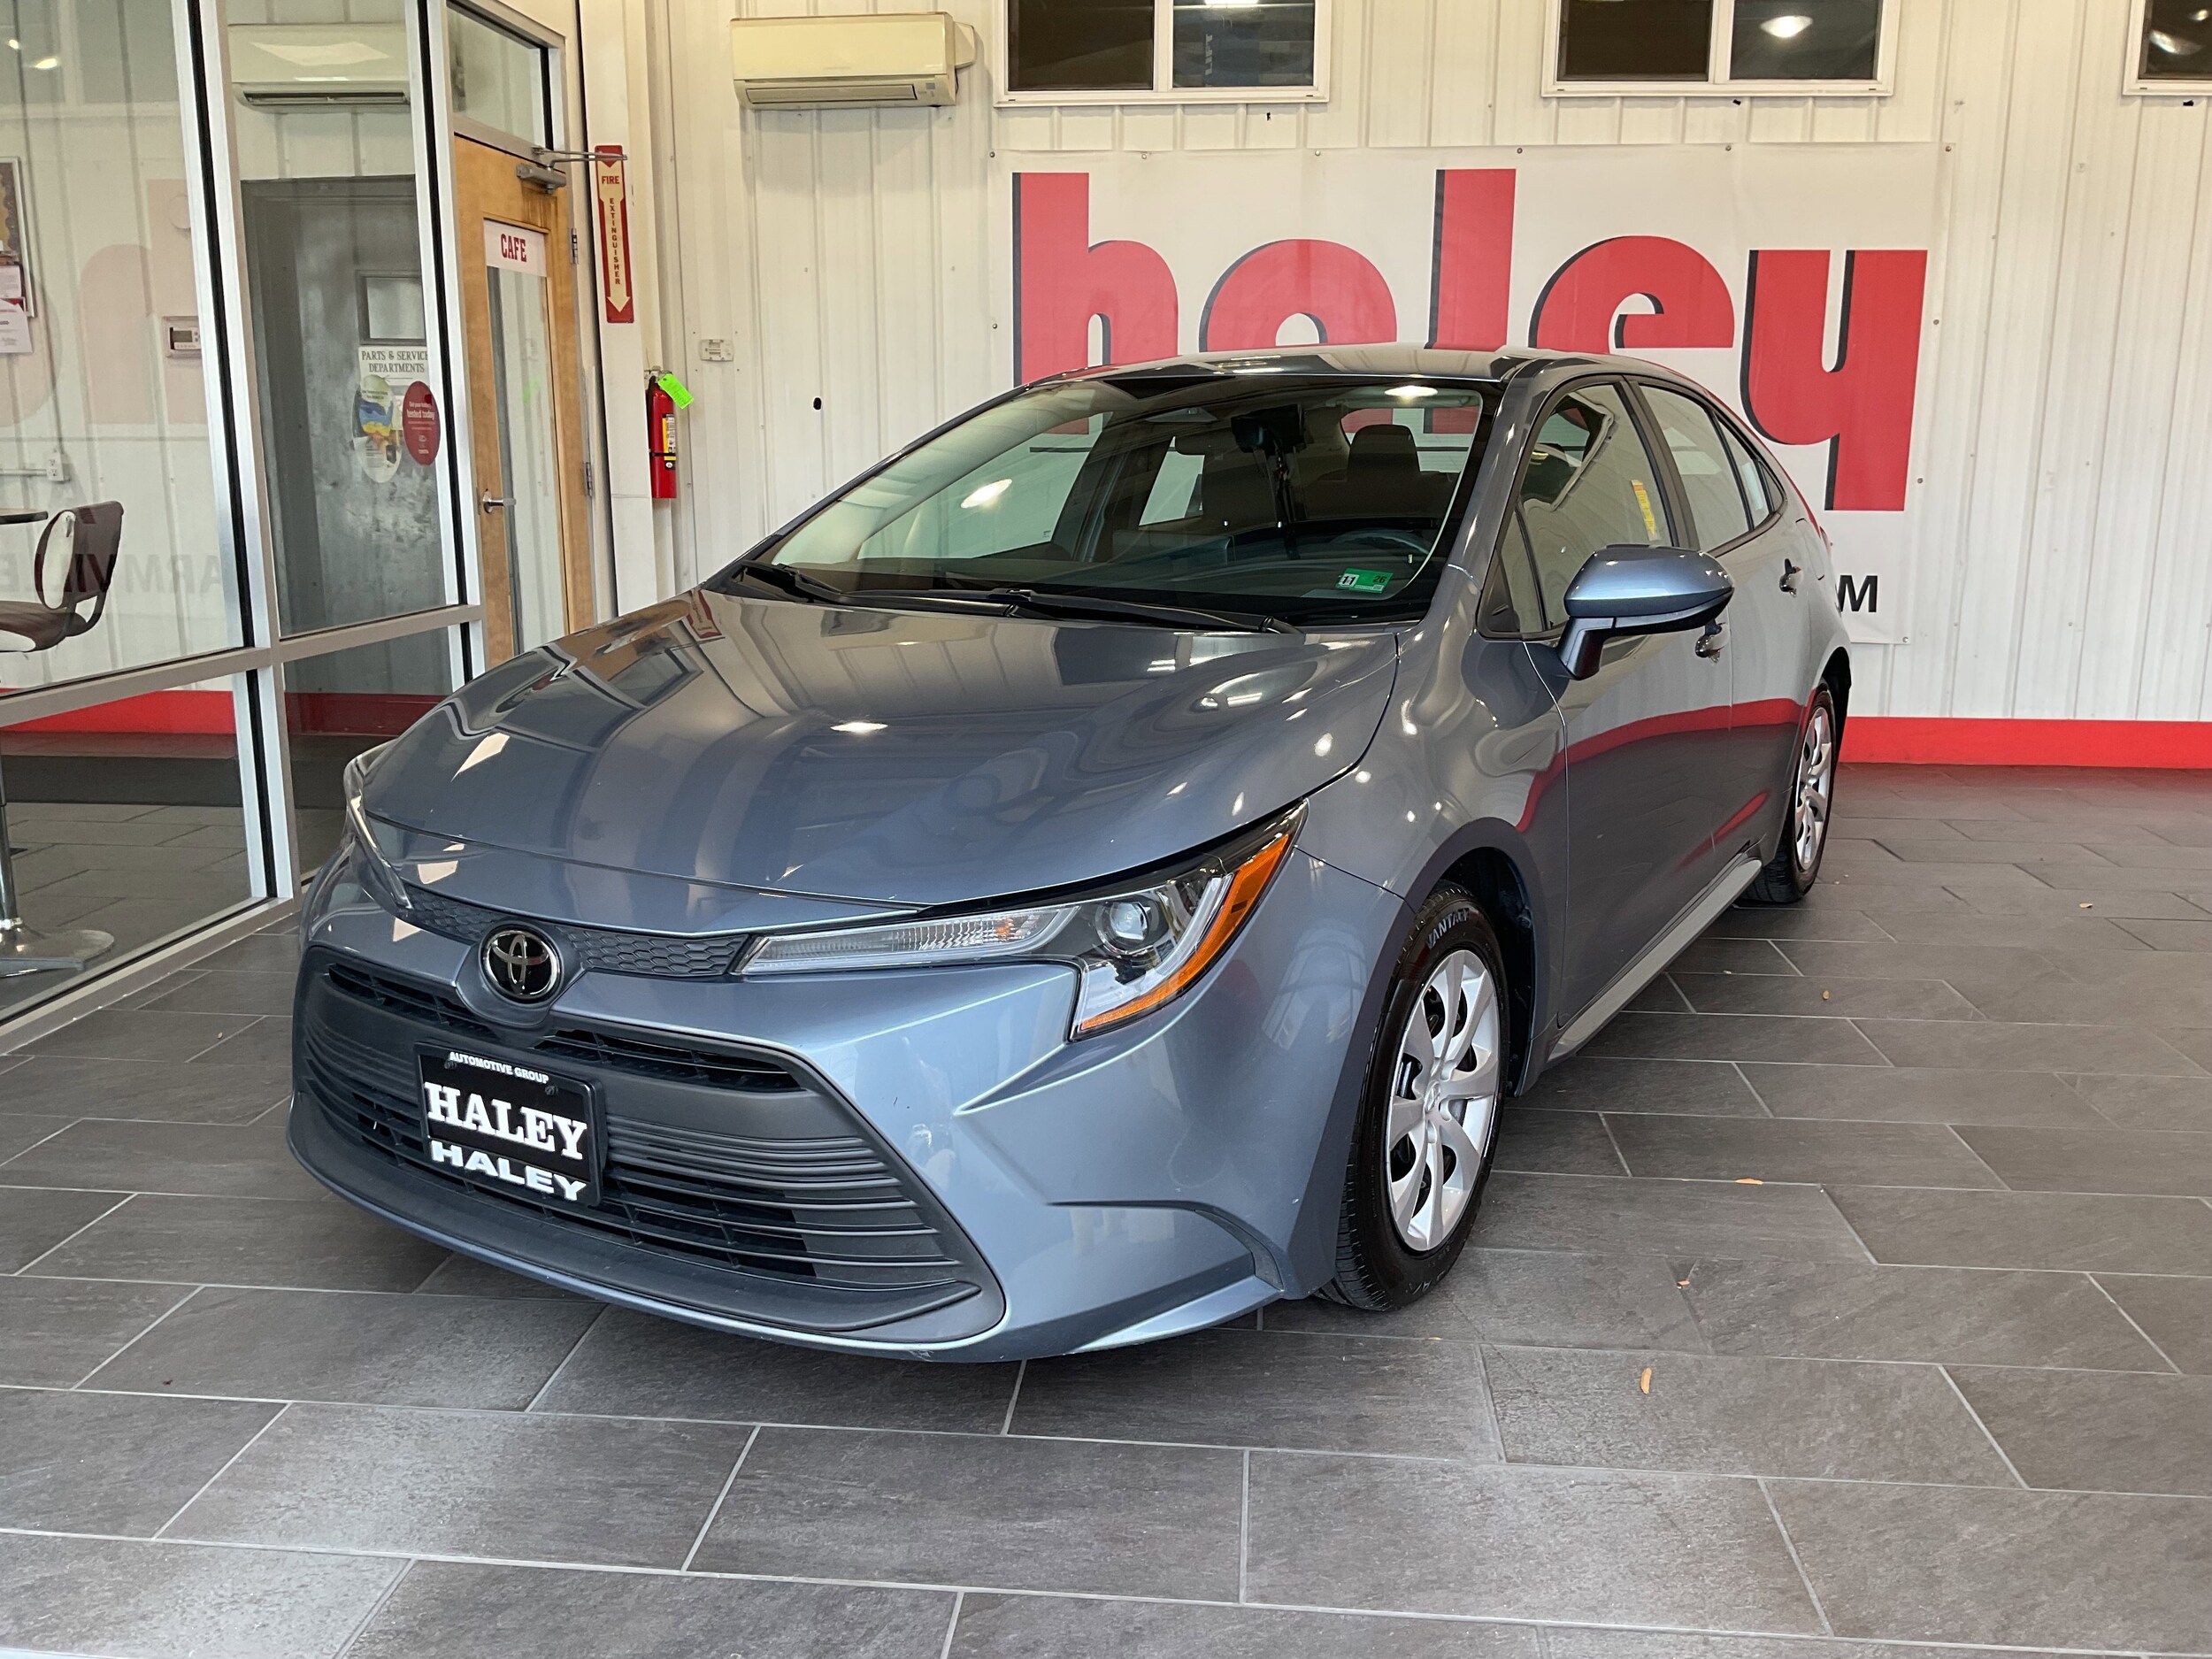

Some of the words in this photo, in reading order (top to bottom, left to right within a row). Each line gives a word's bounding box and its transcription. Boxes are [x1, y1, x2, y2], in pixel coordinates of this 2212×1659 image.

[602, 175, 620, 185] FIRE
[500, 234, 527, 263] CAFE
[609, 197, 621, 285] EXTINGUISHER
[361, 350, 386, 361] PARTS
[388, 350, 395, 360] &
[1012, 169, 1927, 511] haley
[369, 363, 425, 373] DEPARTMENTS
[1342, 575, 1356, 585] 11
[1373, 575, 1387, 584] 26
[449, 1051, 513, 1076] AUTOMOTIVE
[514, 1066, 549, 1084] GROUP
[424, 1081, 588, 1160] HALEY
[431, 1140, 588, 1202] HALEY
